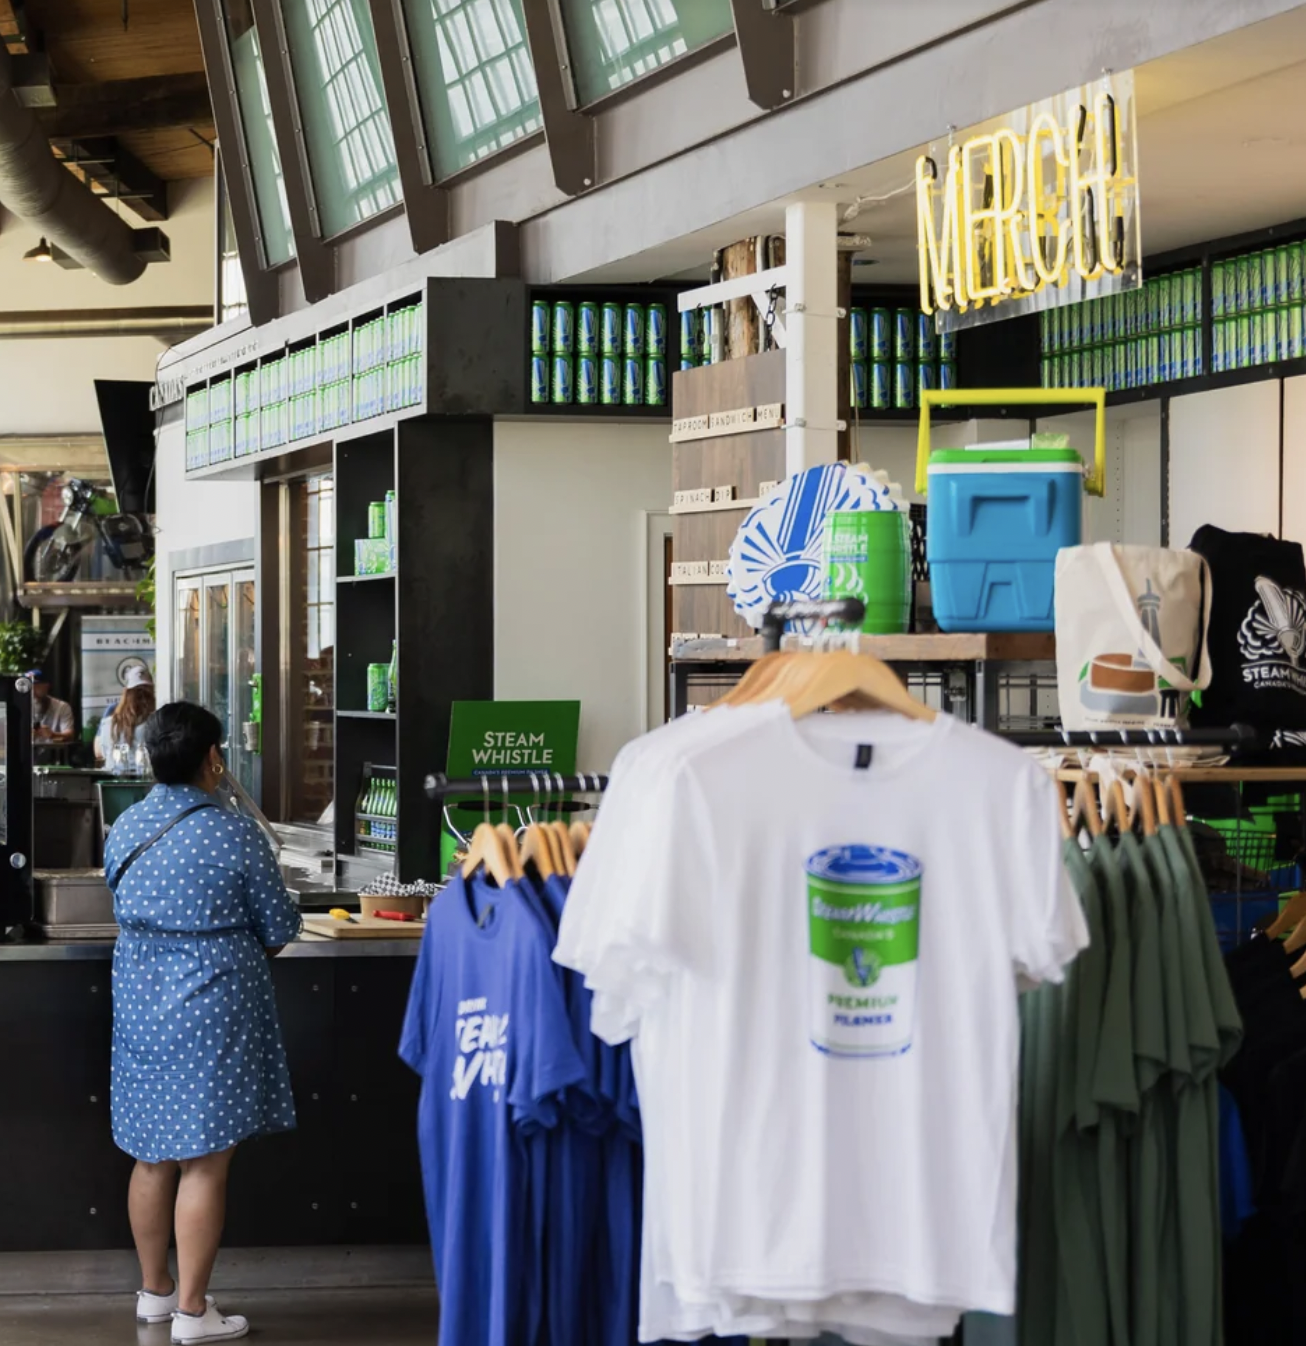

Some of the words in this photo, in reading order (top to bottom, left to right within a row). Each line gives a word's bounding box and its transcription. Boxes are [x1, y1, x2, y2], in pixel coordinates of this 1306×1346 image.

[674, 418, 707, 433] TAPROOM
[710, 411, 752, 429] SANDWICH
[757, 405, 780, 421] MENU
[675, 491, 710, 506] SPINACH
[714, 488, 731, 502] DIP
[674, 563, 707, 577] ITALIAN
[1242, 666, 1291, 683] STEAM
[483, 731, 546, 748] STEAM
[472, 748, 554, 765] WHISTLE
[827, 992, 898, 1010] PREMIUM
